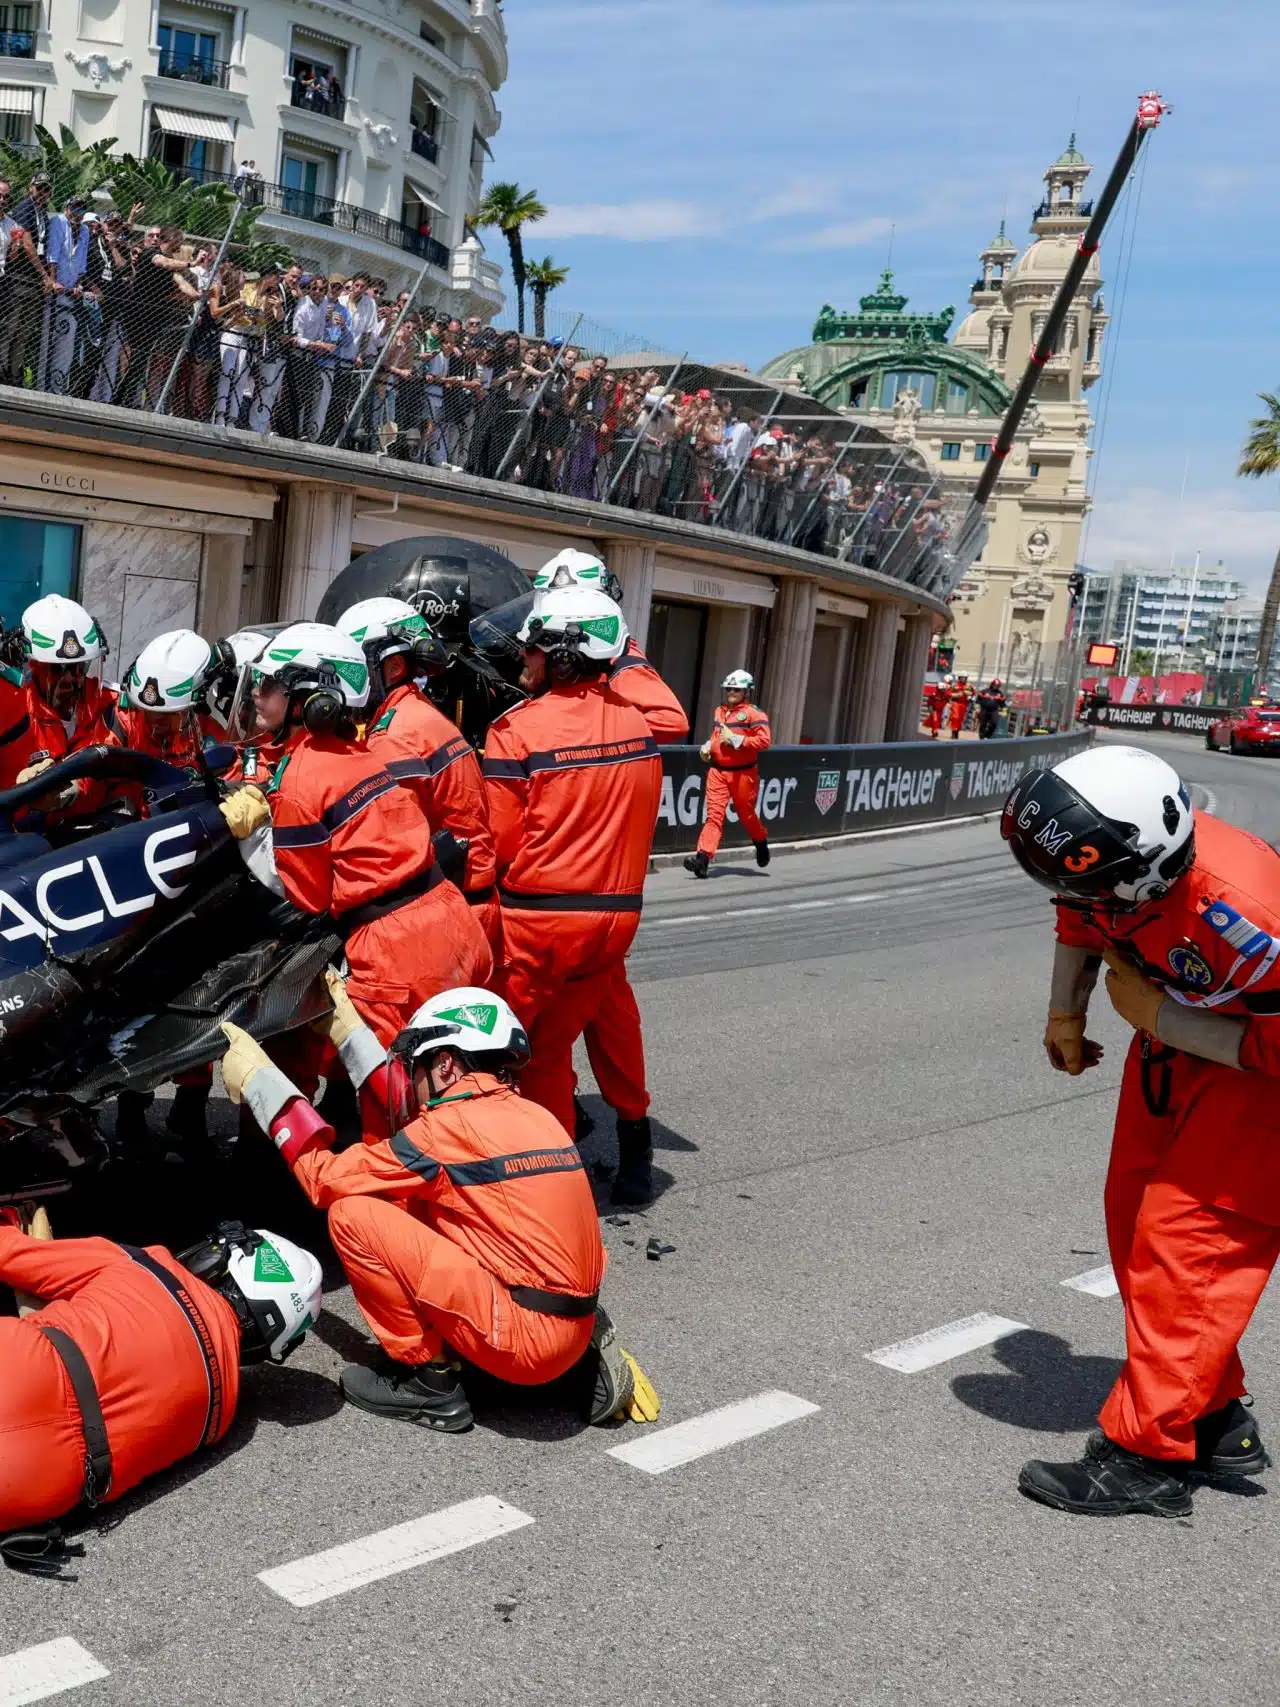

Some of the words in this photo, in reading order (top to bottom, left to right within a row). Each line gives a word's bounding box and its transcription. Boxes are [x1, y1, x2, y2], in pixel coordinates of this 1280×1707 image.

[41, 472, 95, 491] GUCCI
[425, 600, 459, 616] Rock
[587, 619, 615, 637] ACM
[1109, 708, 1156, 725] TAGHeuer
[820, 774, 838, 788] TAG
[845, 767, 942, 813] TAGHeuer
[504, 1153, 561, 1174] AUTOMOBILE
[261, 1247, 285, 1276] ACM
[290, 1292, 305, 1313] 483
[176, 1289, 214, 1357] AUTOMOBILE
